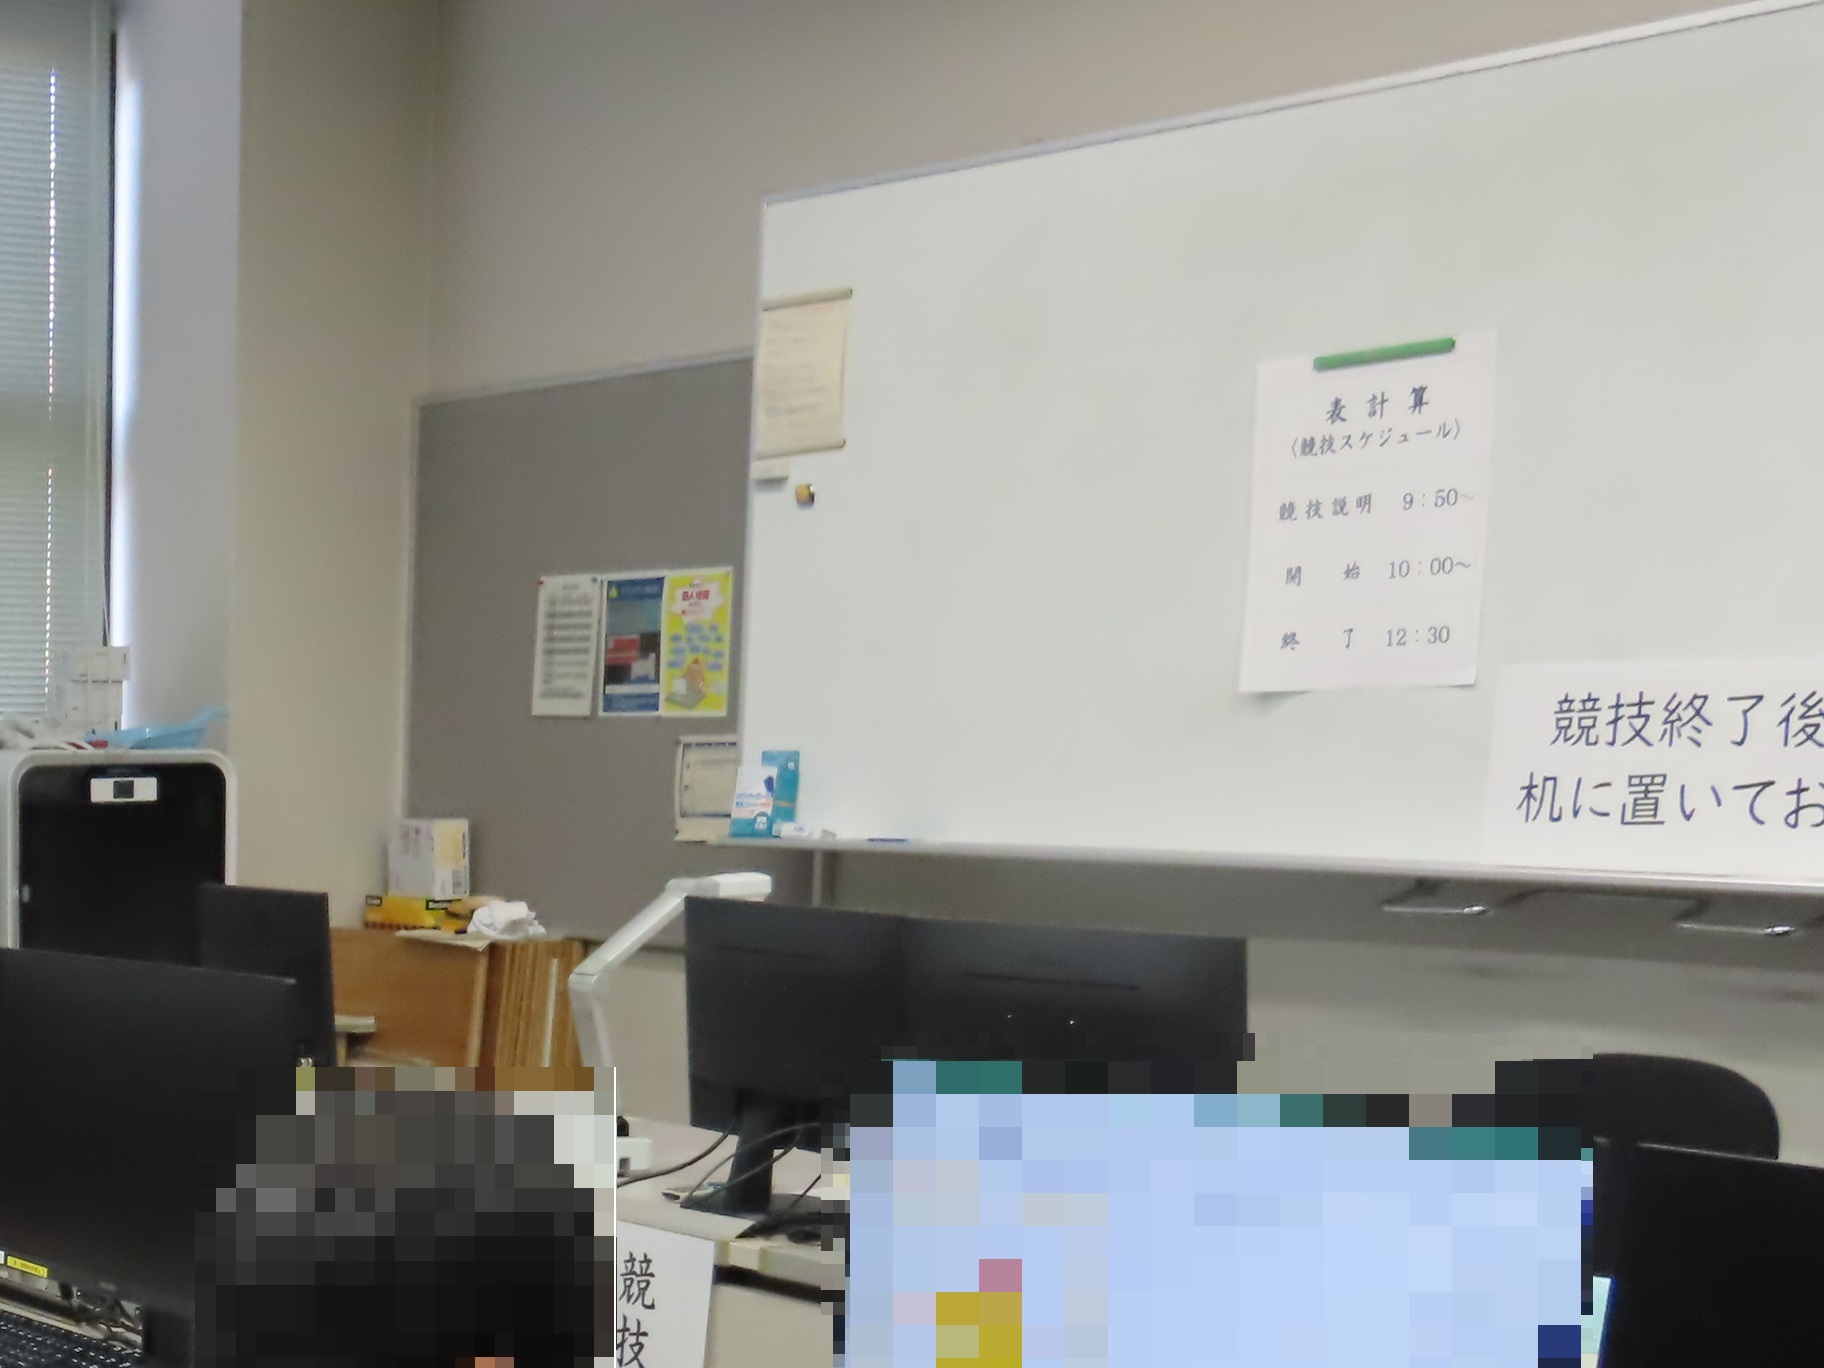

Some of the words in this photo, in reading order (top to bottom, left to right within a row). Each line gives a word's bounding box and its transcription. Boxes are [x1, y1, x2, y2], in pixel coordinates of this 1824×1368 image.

[1326, 385, 1429, 425] 表計算
[1279, 493, 1373, 521] 競技説明
[1285, 556, 1360, 587] 開始
[1280, 627, 1355, 651] 終了
[1386, 625, 1450, 647] 12:30
[1550, 690, 1824, 749] 競技終了後
